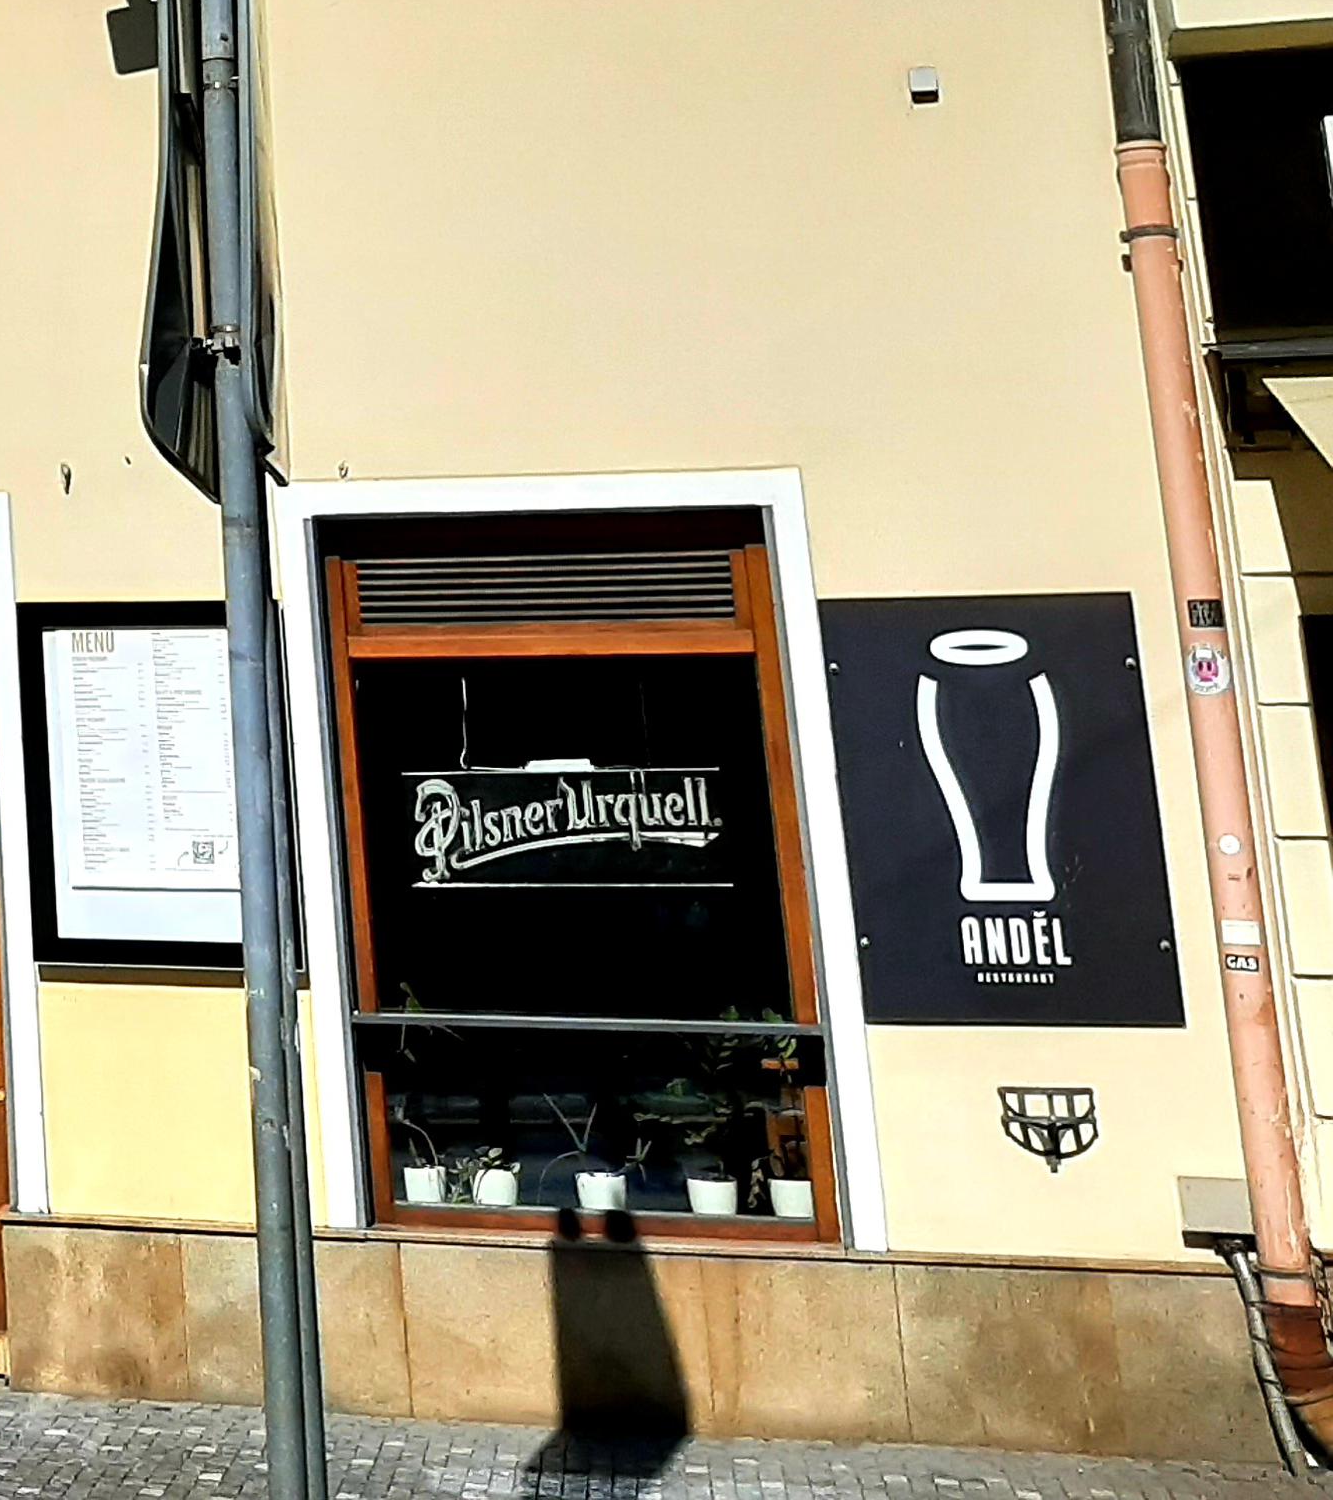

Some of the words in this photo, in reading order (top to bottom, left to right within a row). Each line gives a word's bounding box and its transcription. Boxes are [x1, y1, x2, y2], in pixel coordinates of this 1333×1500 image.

[71, 631, 115, 654] MENU
[414, 778, 564, 883] Pilsner
[960, 910, 1073, 966] ANDĚL
